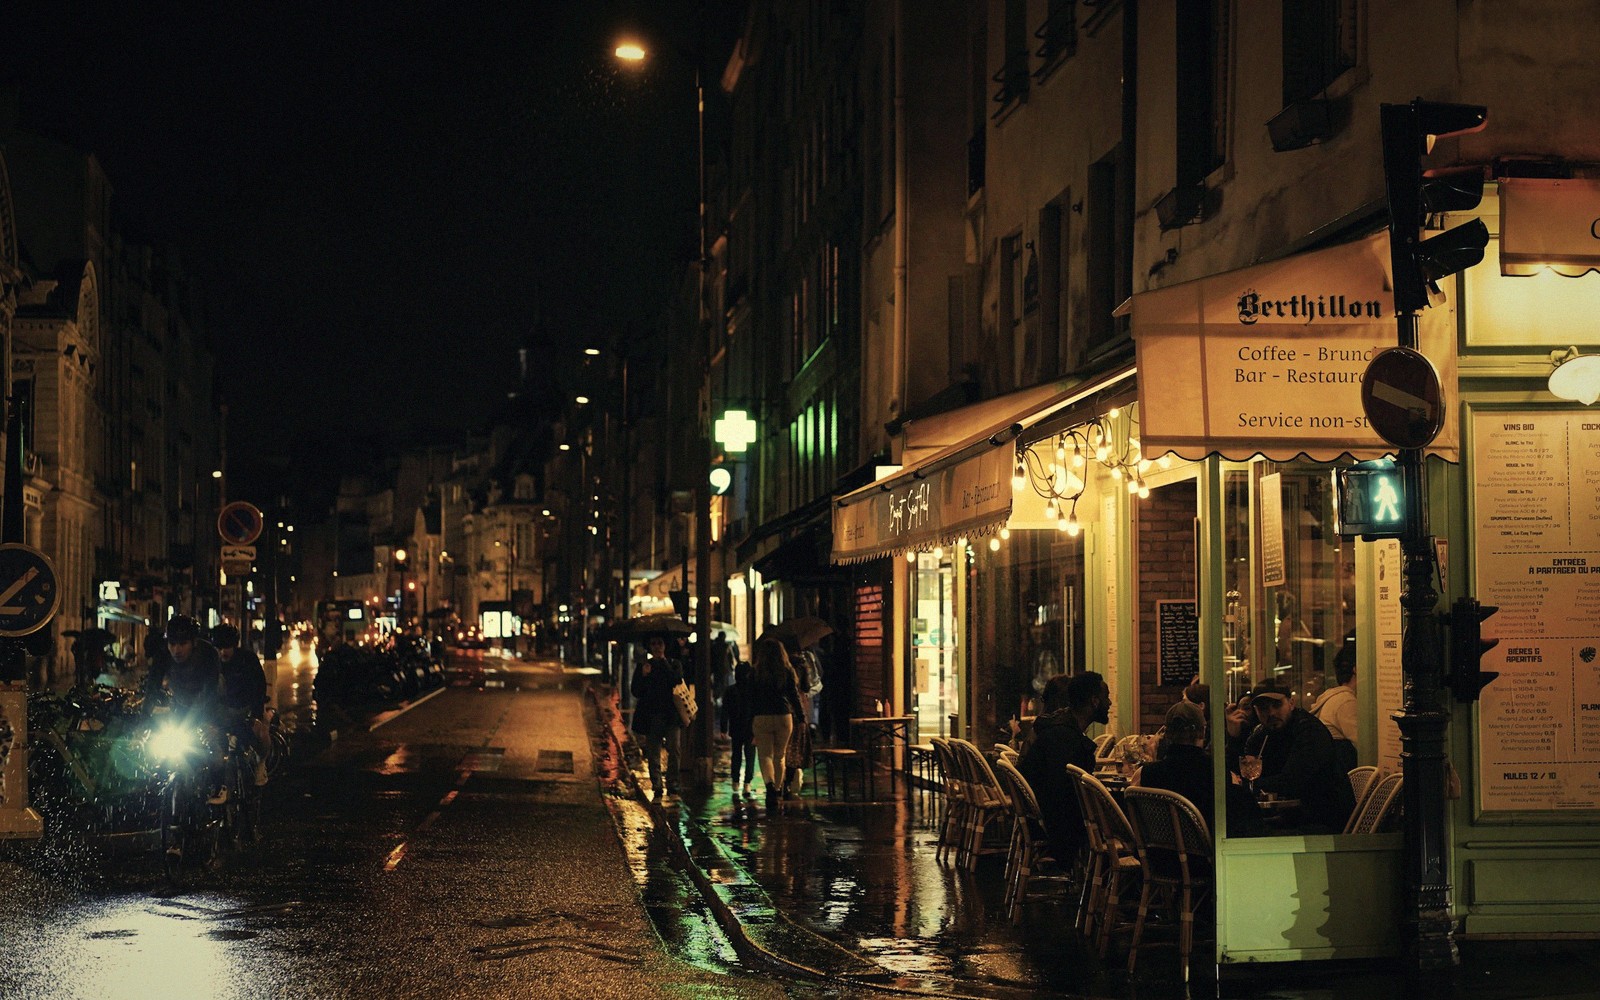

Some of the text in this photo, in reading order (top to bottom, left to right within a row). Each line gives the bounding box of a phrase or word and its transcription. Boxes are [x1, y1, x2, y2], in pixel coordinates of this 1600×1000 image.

[1237, 288, 1382, 327] Berthillon
[1238, 346, 1296, 361] Coffee
[1318, 347, 1372, 361] Brunc
[1235, 368, 1267, 383] Bar
[1238, 412, 1370, 428] Service non-st
[1553, 557, 1586, 566] ENTRÉES
[1508, 646, 1533, 655] BIÈRES
[1504, 772, 1528, 780] MULES
[1530, 772, 1539, 780] 12
[1548, 772, 1556, 780] 10
